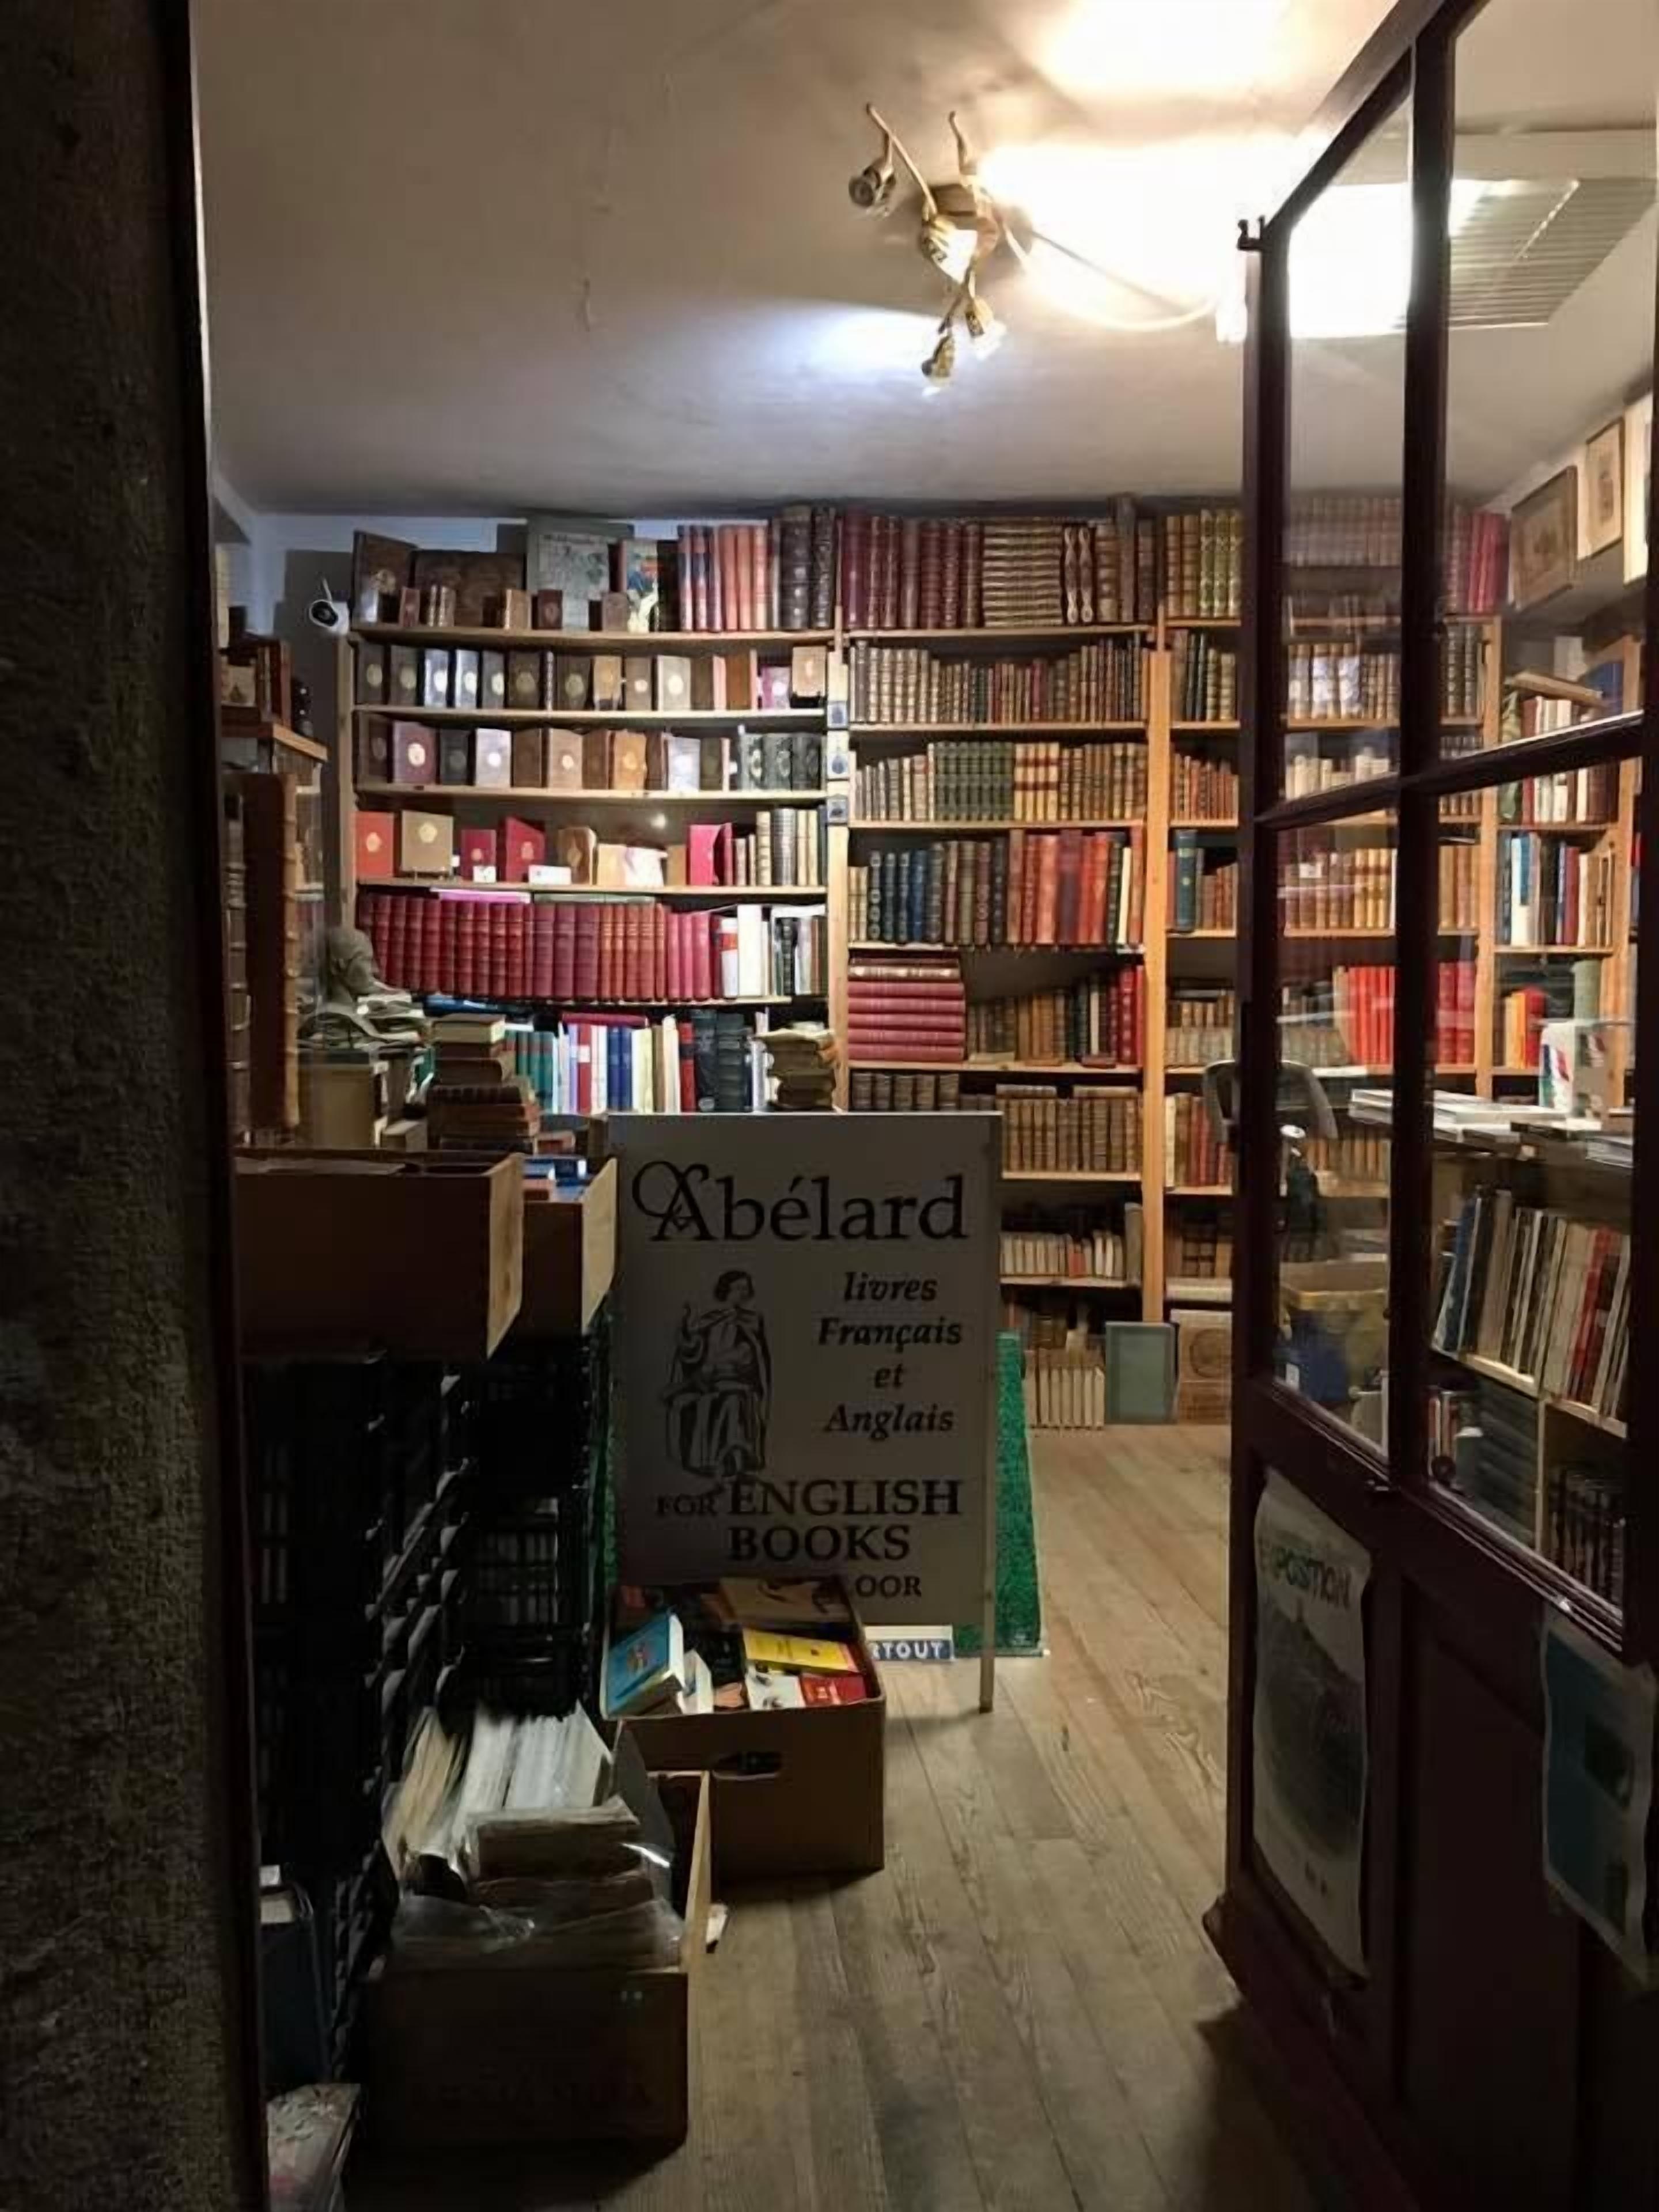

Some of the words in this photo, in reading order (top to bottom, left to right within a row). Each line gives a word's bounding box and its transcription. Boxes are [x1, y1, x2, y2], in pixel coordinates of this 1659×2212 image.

[632, 1161, 968, 1241] Abélard
[844, 1272, 938, 1301] livres
[818, 1317, 961, 1353] Français
[874, 1363, 905, 1389] et
[823, 1404, 955, 1442] Anglais
[656, 1493, 718, 1516] FOR
[728, 1479, 961, 1516] ENGLISH
[729, 1524, 911, 1562] BOOKS
[855, 1575, 922, 1597] OOR
[869, 1641, 944, 1660] RTOUT
